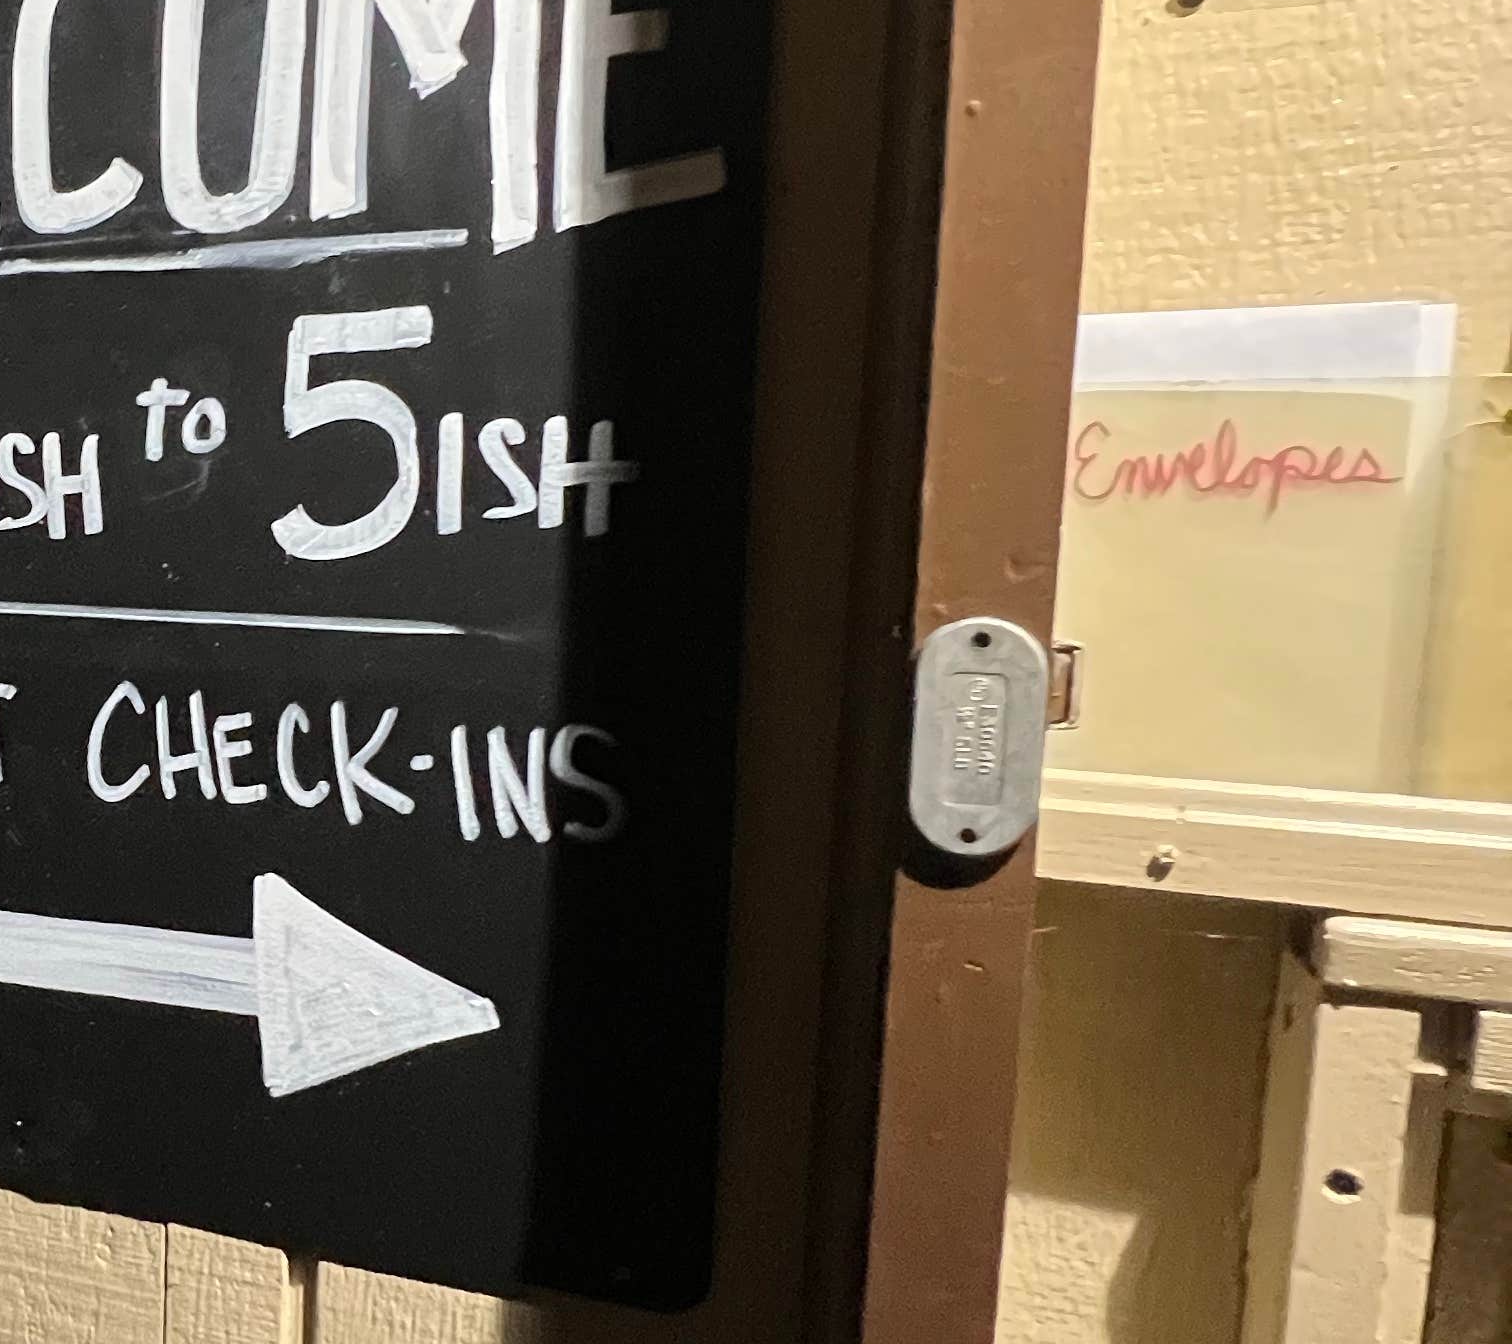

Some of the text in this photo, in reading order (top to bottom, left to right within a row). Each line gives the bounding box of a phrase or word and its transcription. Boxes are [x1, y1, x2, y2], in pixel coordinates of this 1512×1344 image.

[135, 377, 227, 463] to
[1074, 419, 1404, 522] Envelopes
[87, 680, 628, 843] CHECK-INS
